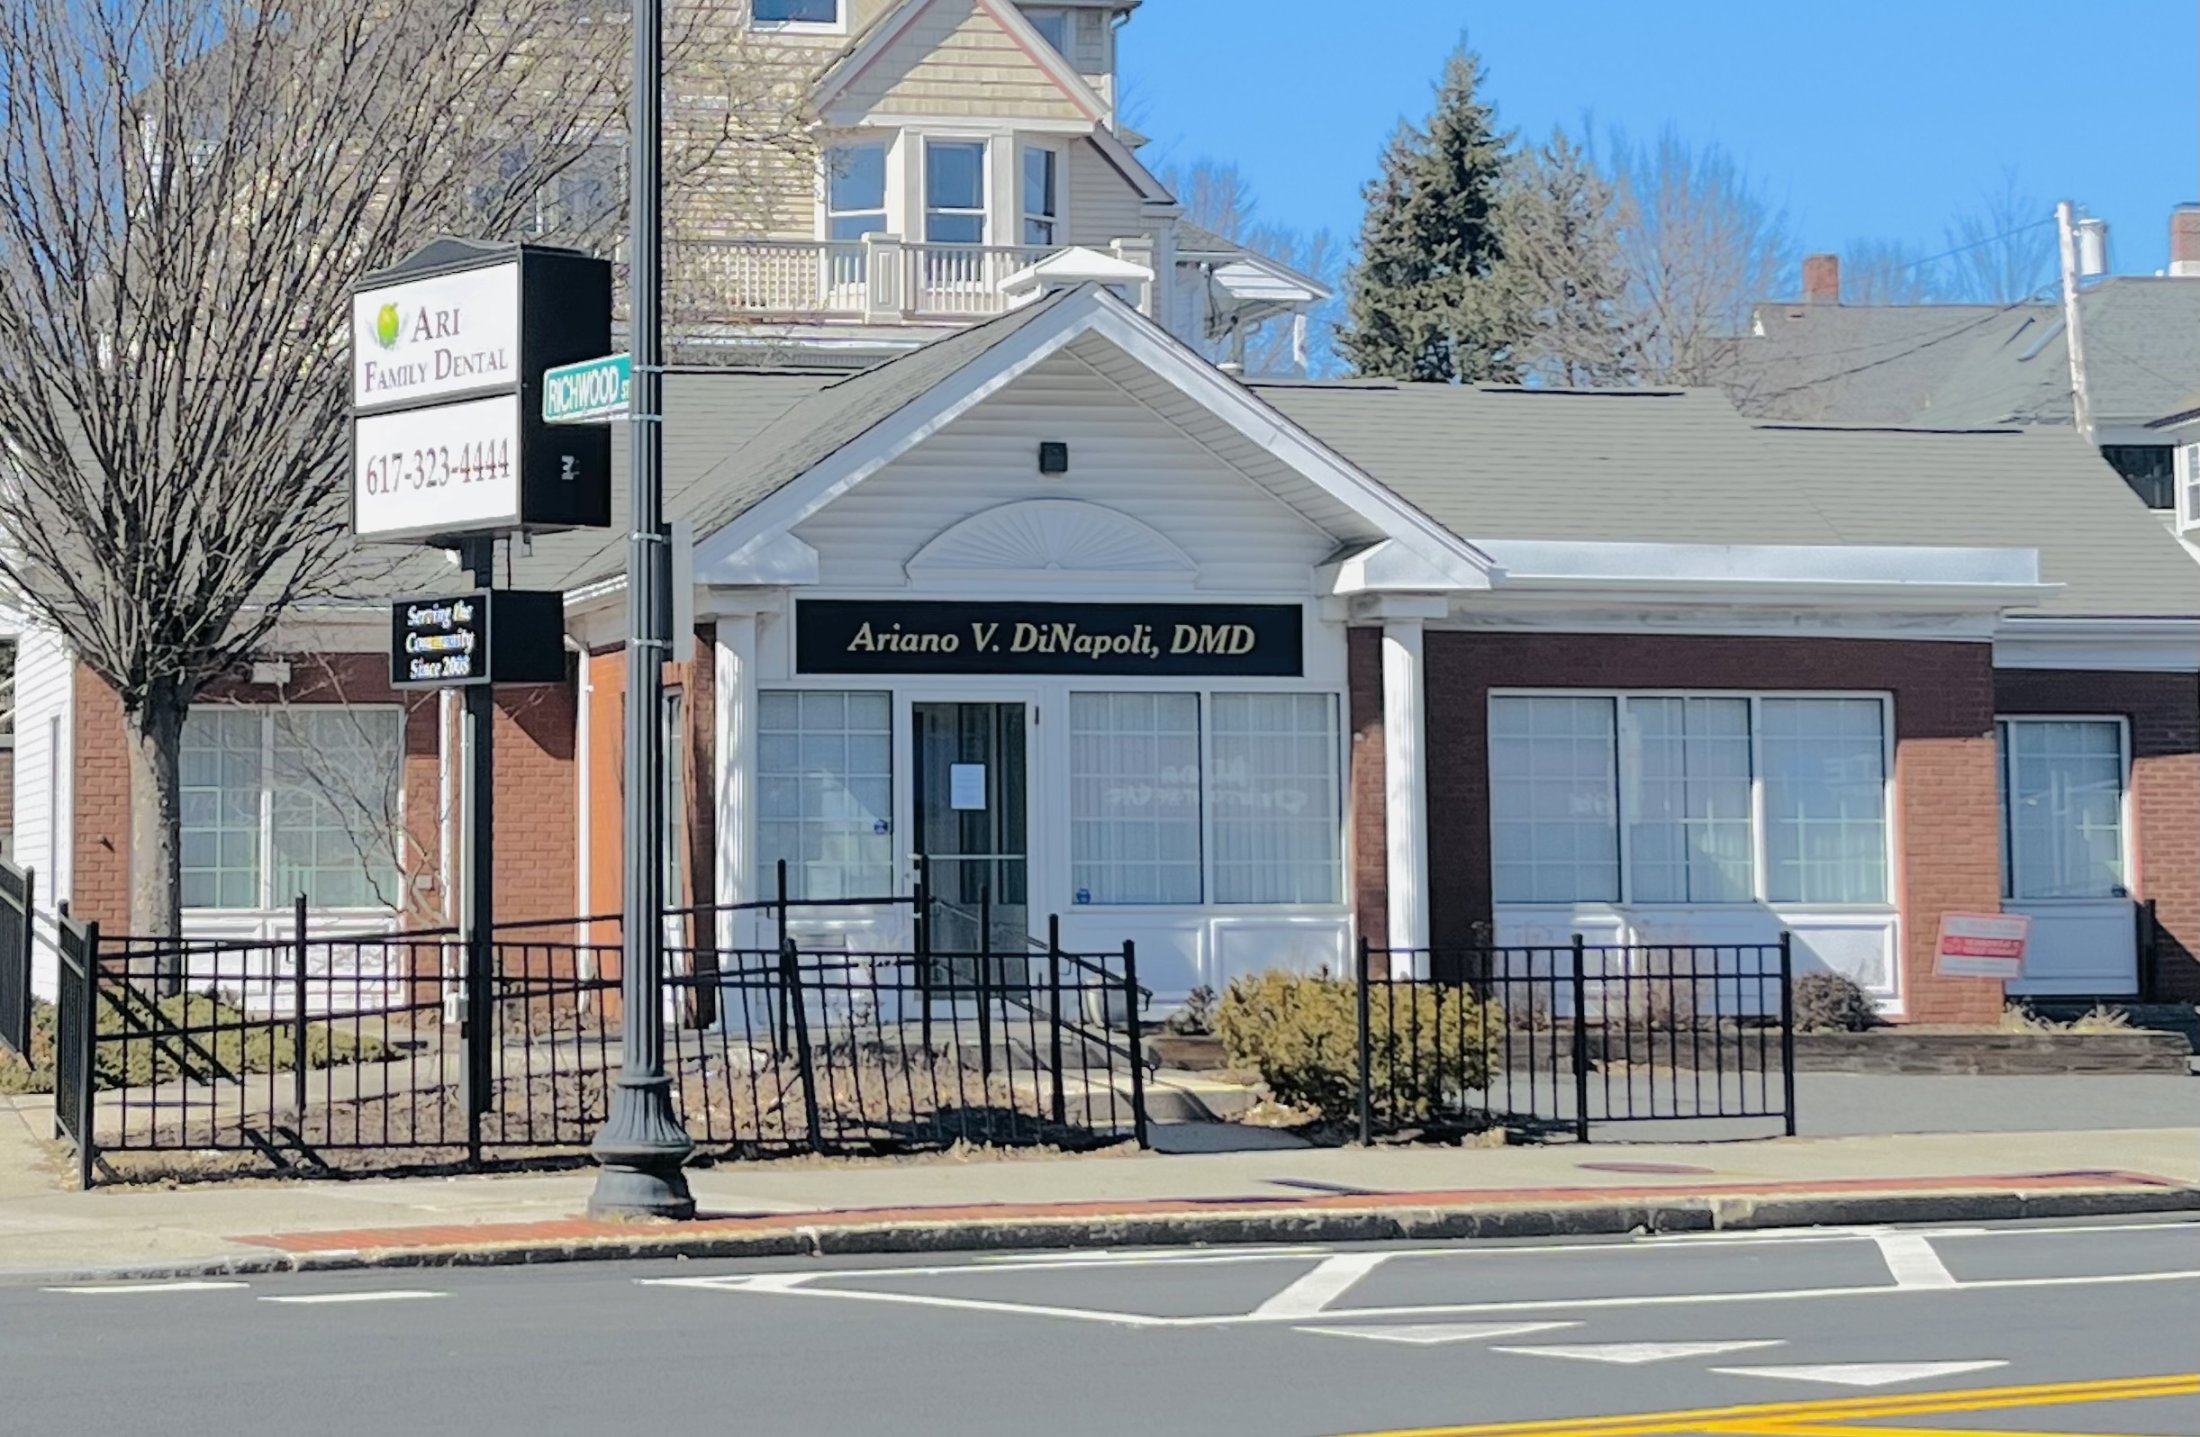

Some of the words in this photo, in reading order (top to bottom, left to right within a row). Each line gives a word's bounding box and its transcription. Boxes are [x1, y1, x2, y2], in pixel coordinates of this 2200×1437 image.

[548, 365, 618, 414] RICHWOOD
[366, 437, 511, 496] 617-323-4444
[407, 603, 452, 629] Serving
[405, 628, 475, 654] Community
[847, 622, 959, 653] Ariano
[971, 623, 1001, 652] V.
[1010, 623, 1160, 660] DiNapoli,
[1169, 624, 1256, 655] DMD
[409, 656, 441, 680] Since
